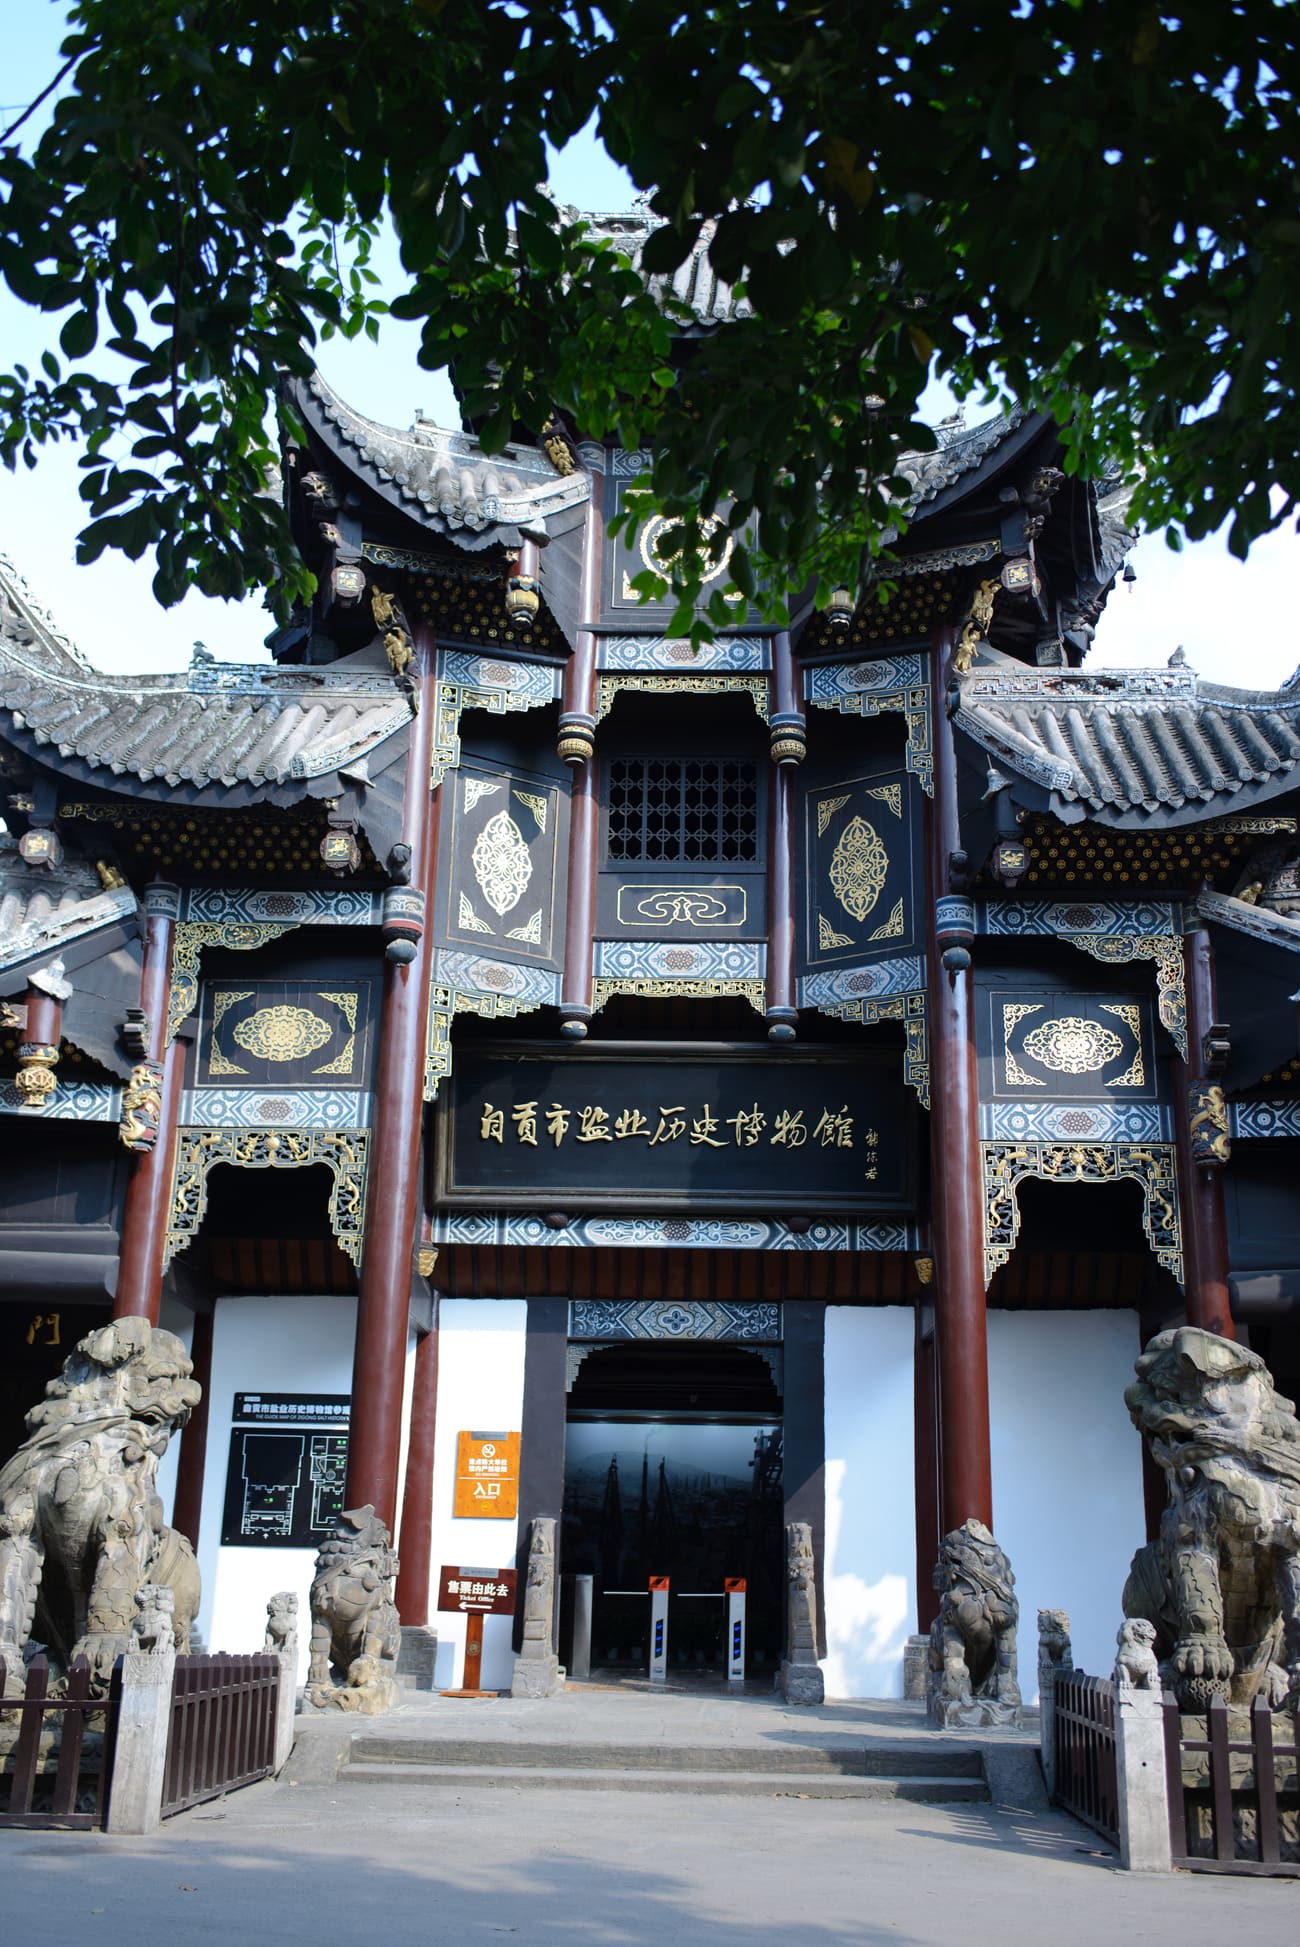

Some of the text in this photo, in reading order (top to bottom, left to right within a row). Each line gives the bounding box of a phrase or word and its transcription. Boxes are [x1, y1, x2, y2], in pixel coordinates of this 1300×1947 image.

[473, 1482, 500, 1496] 入口
[447, 1580, 509, 1597] 售票由此去
